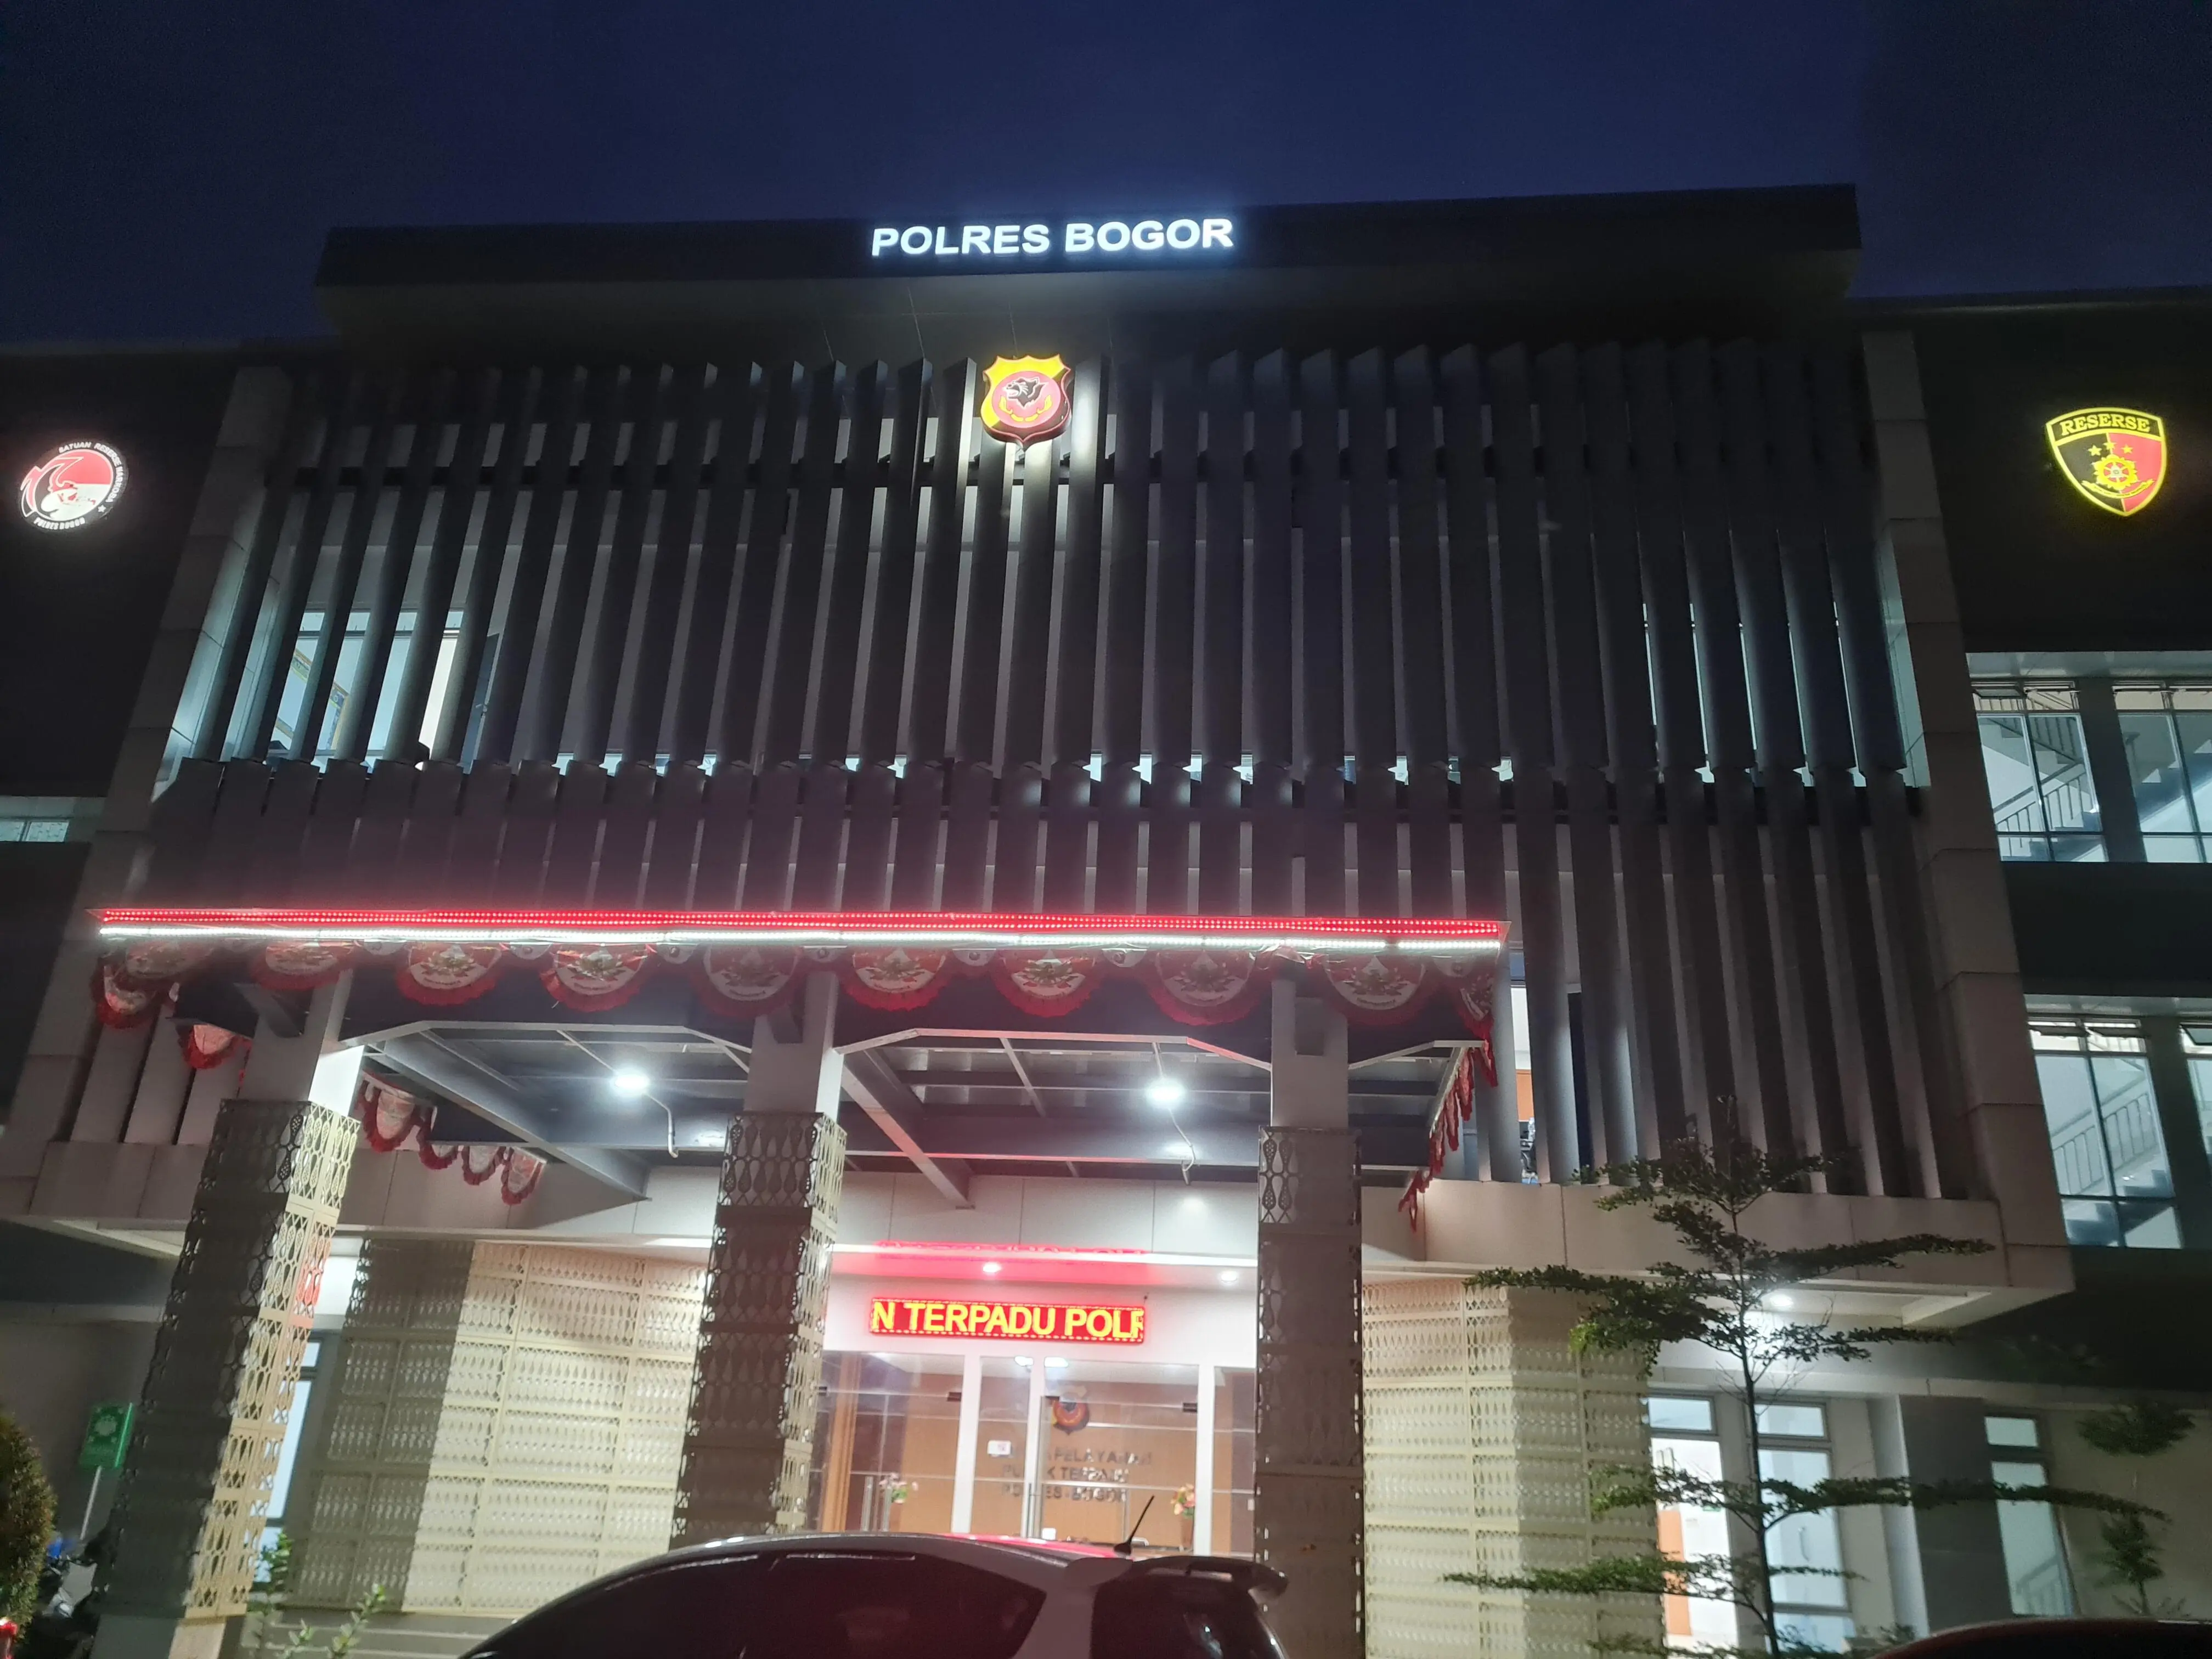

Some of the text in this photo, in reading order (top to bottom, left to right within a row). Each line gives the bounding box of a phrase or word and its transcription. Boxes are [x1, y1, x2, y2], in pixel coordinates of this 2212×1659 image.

[871, 218, 1234, 257] POLRES BOGOR
[2059, 413, 2151, 436] RESERSE
[58, 442, 92, 454] SATUAN
[903, 1302, 1056, 1335] TERPADU
